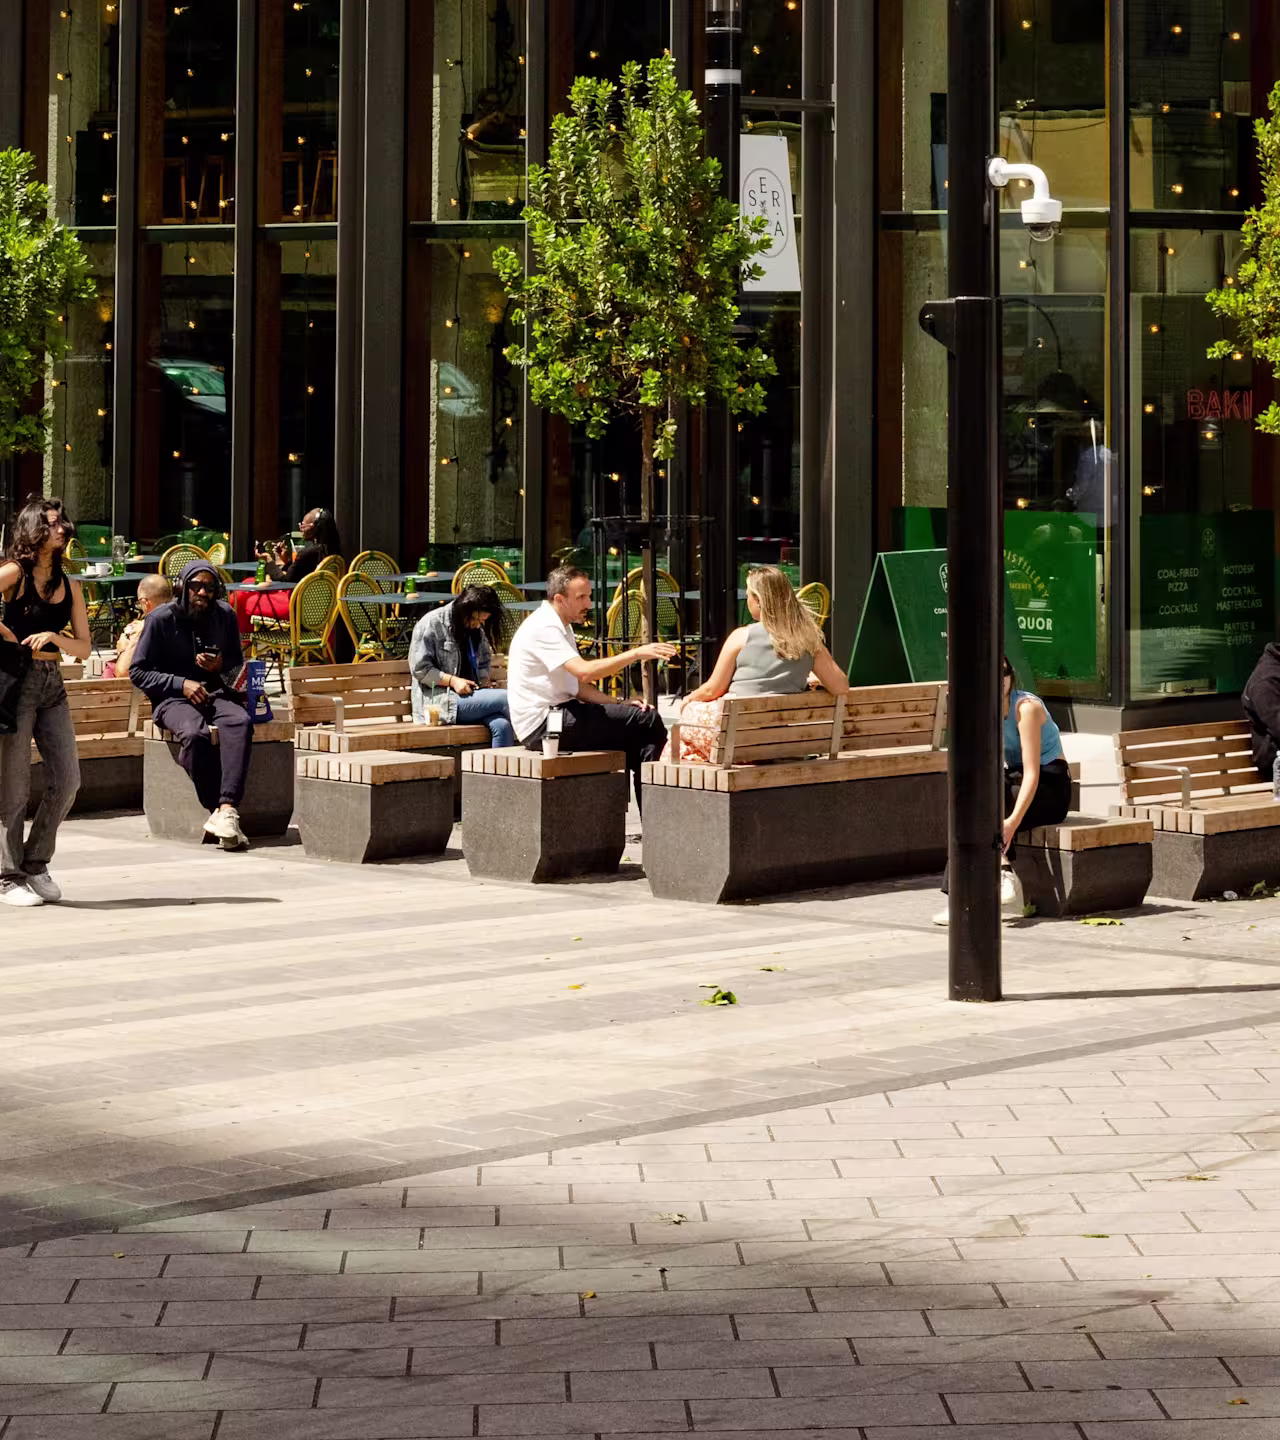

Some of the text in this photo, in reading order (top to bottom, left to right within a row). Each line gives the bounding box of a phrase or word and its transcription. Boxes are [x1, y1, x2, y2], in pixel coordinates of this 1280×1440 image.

[1187, 389, 1253, 420] BAKI
[1157, 567, 1200, 579] COAL-FIRED
[1167, 581, 1189, 592] PIZZA
[1222, 585, 1257, 597] COCKTAIL
[1158, 603, 1199, 616] COCKTAILS
[1216, 598, 1263, 611] MASTERCLASS
[1017, 615, 1053, 631] QUOR
